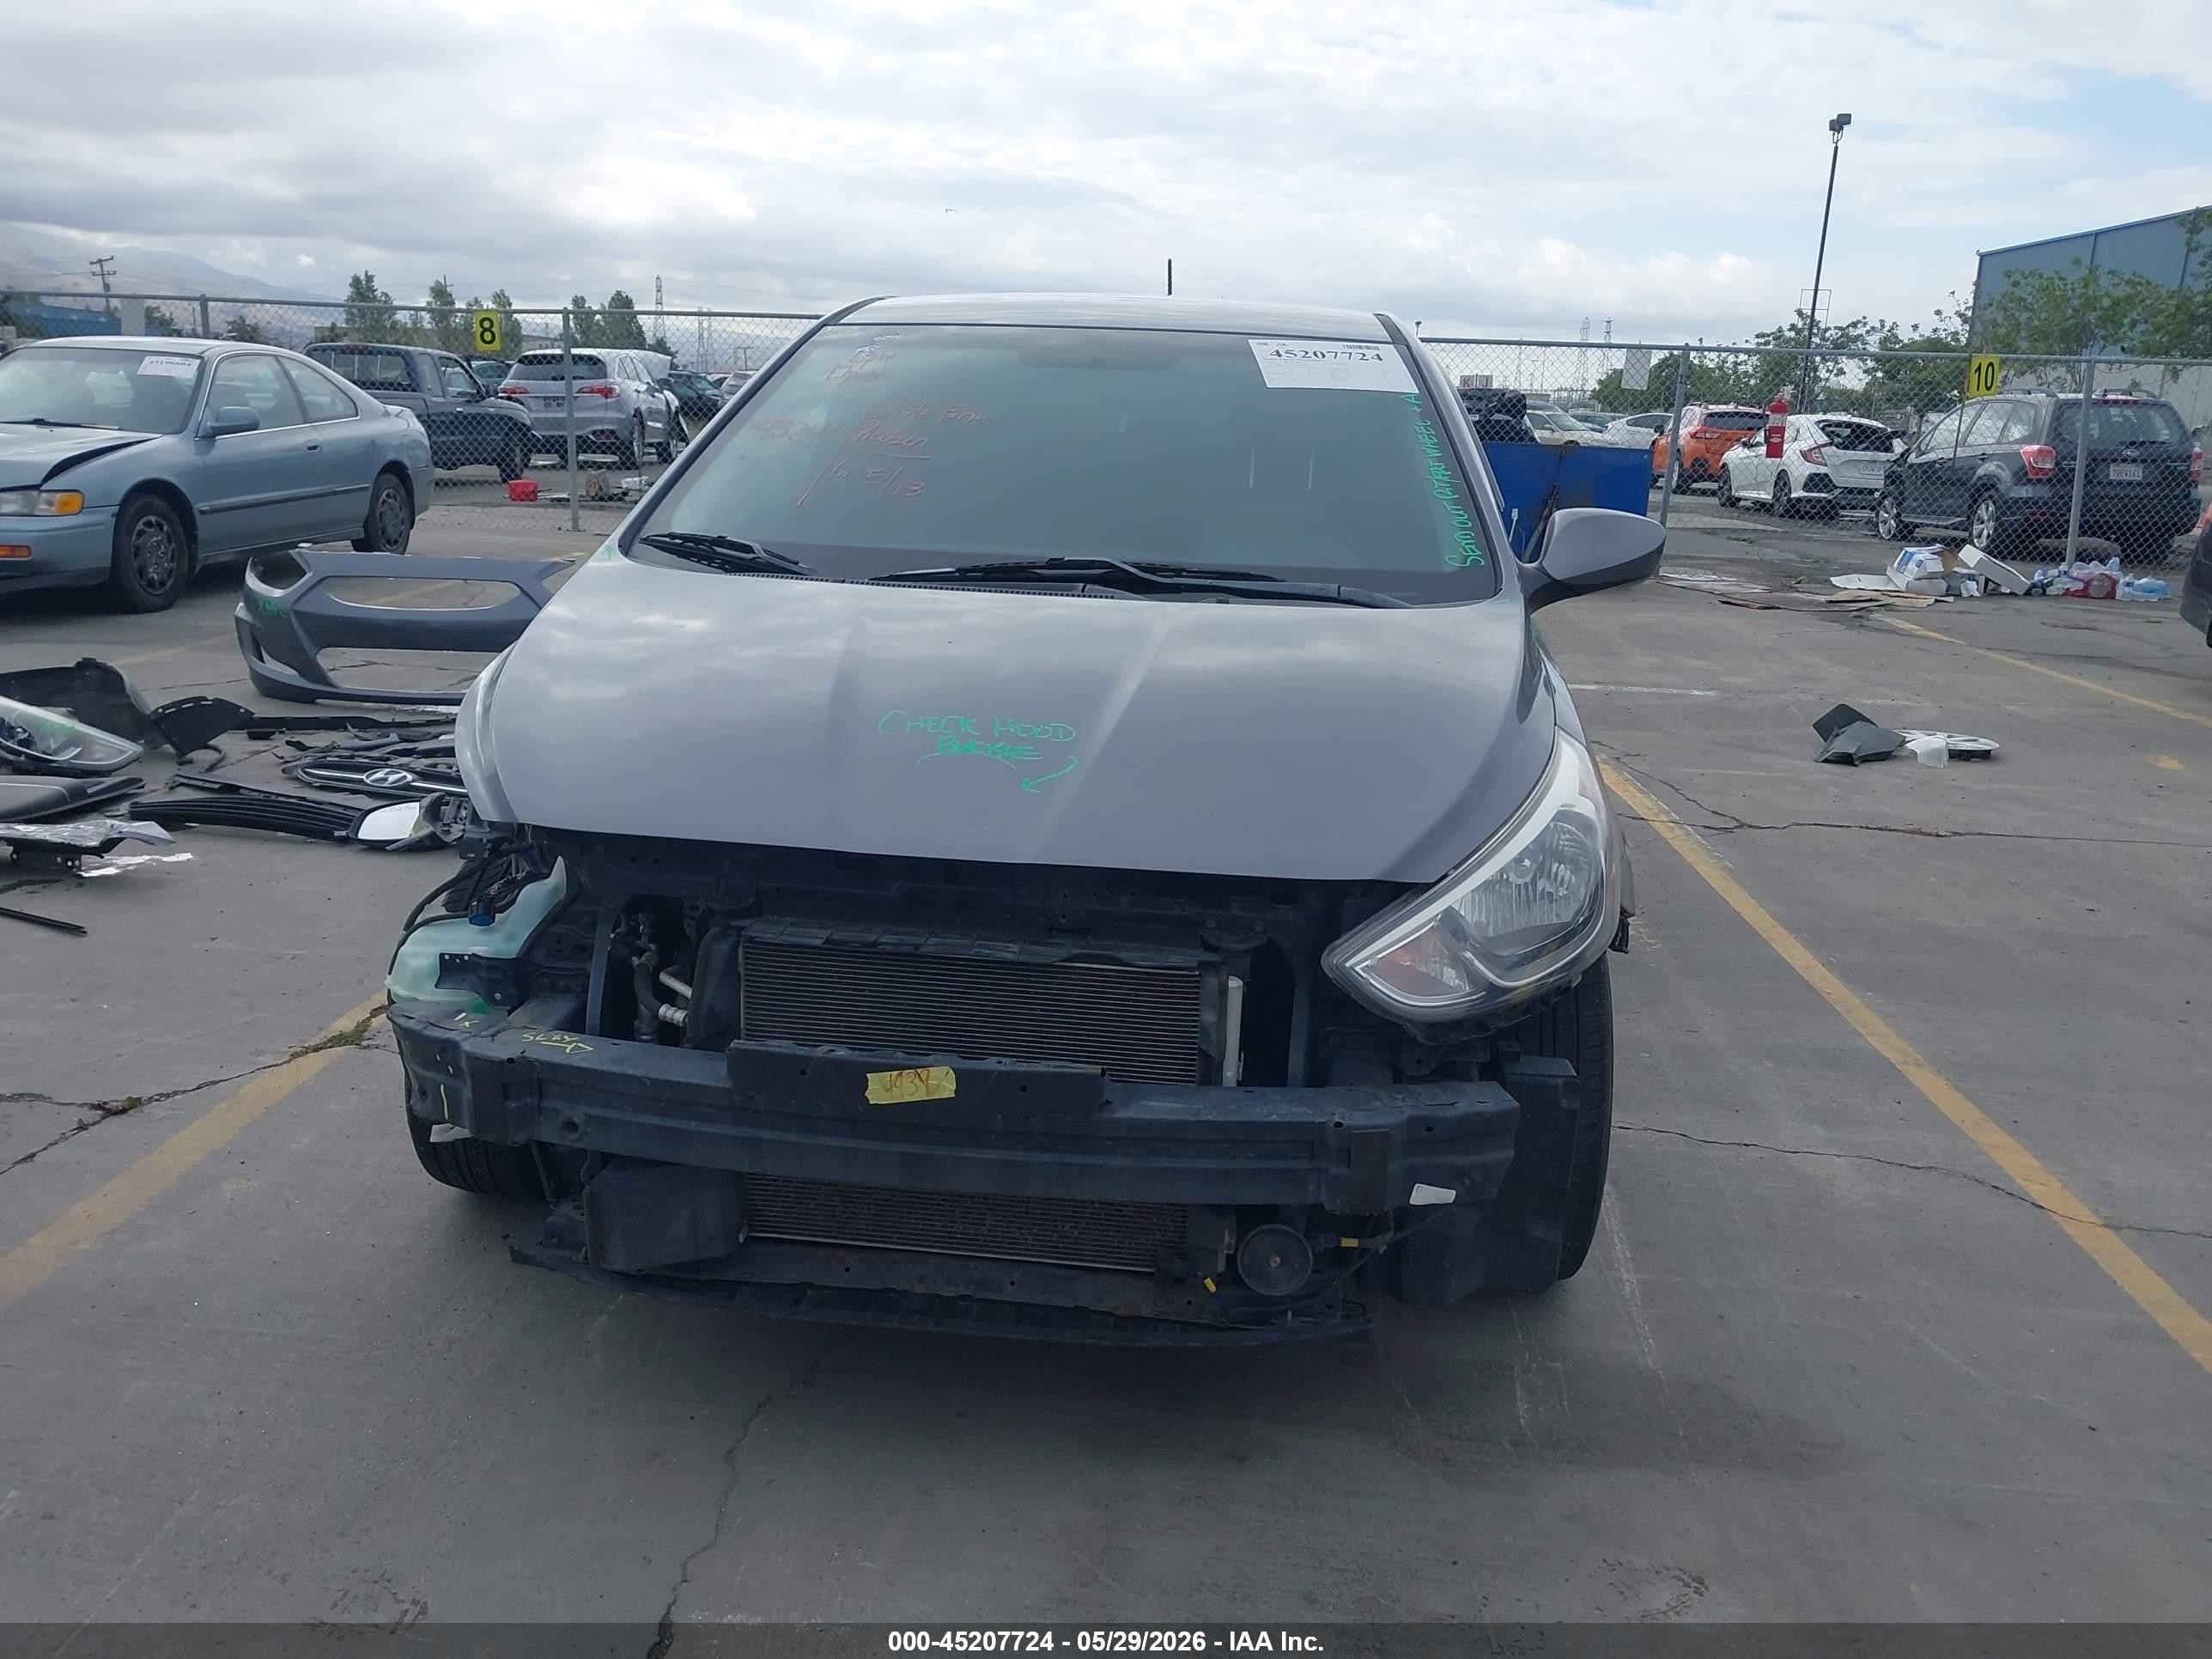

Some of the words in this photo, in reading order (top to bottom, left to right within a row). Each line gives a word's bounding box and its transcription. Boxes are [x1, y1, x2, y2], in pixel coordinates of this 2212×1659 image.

[478, 316, 496, 344] 8
[1269, 349, 1384, 362] 45207724
[1463, 378, 1471, 387] K
[1974, 362, 1996, 392] 10
[1443, 501, 1473, 527] OUT
[878, 709, 981, 735] CHECK
[994, 716, 1076, 742] HOOD
